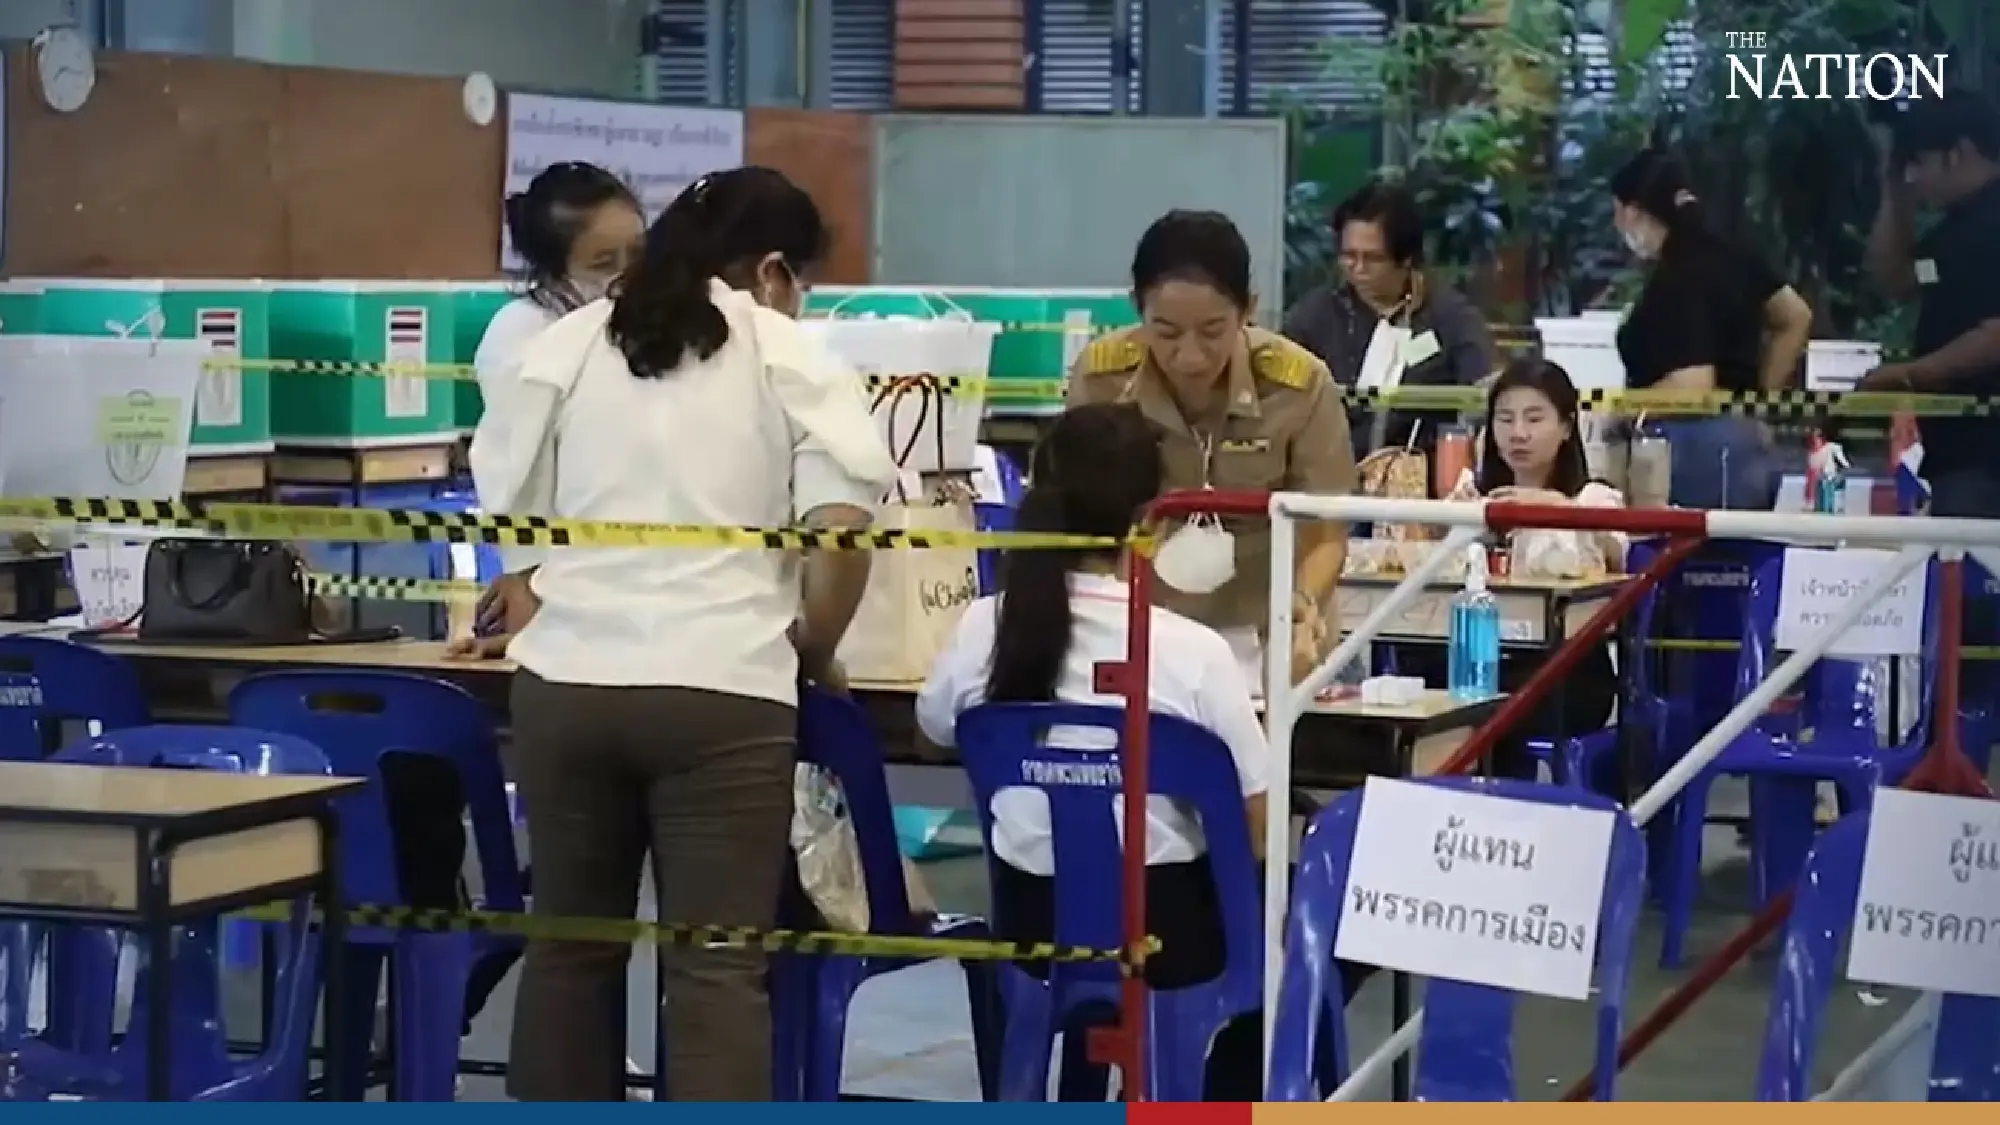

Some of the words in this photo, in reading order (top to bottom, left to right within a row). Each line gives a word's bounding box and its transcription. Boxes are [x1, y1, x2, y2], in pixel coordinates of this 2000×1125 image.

[1432, 814, 1536, 873] ผู้แทน
[1352, 884, 1586, 954] พรรคการเมือง
